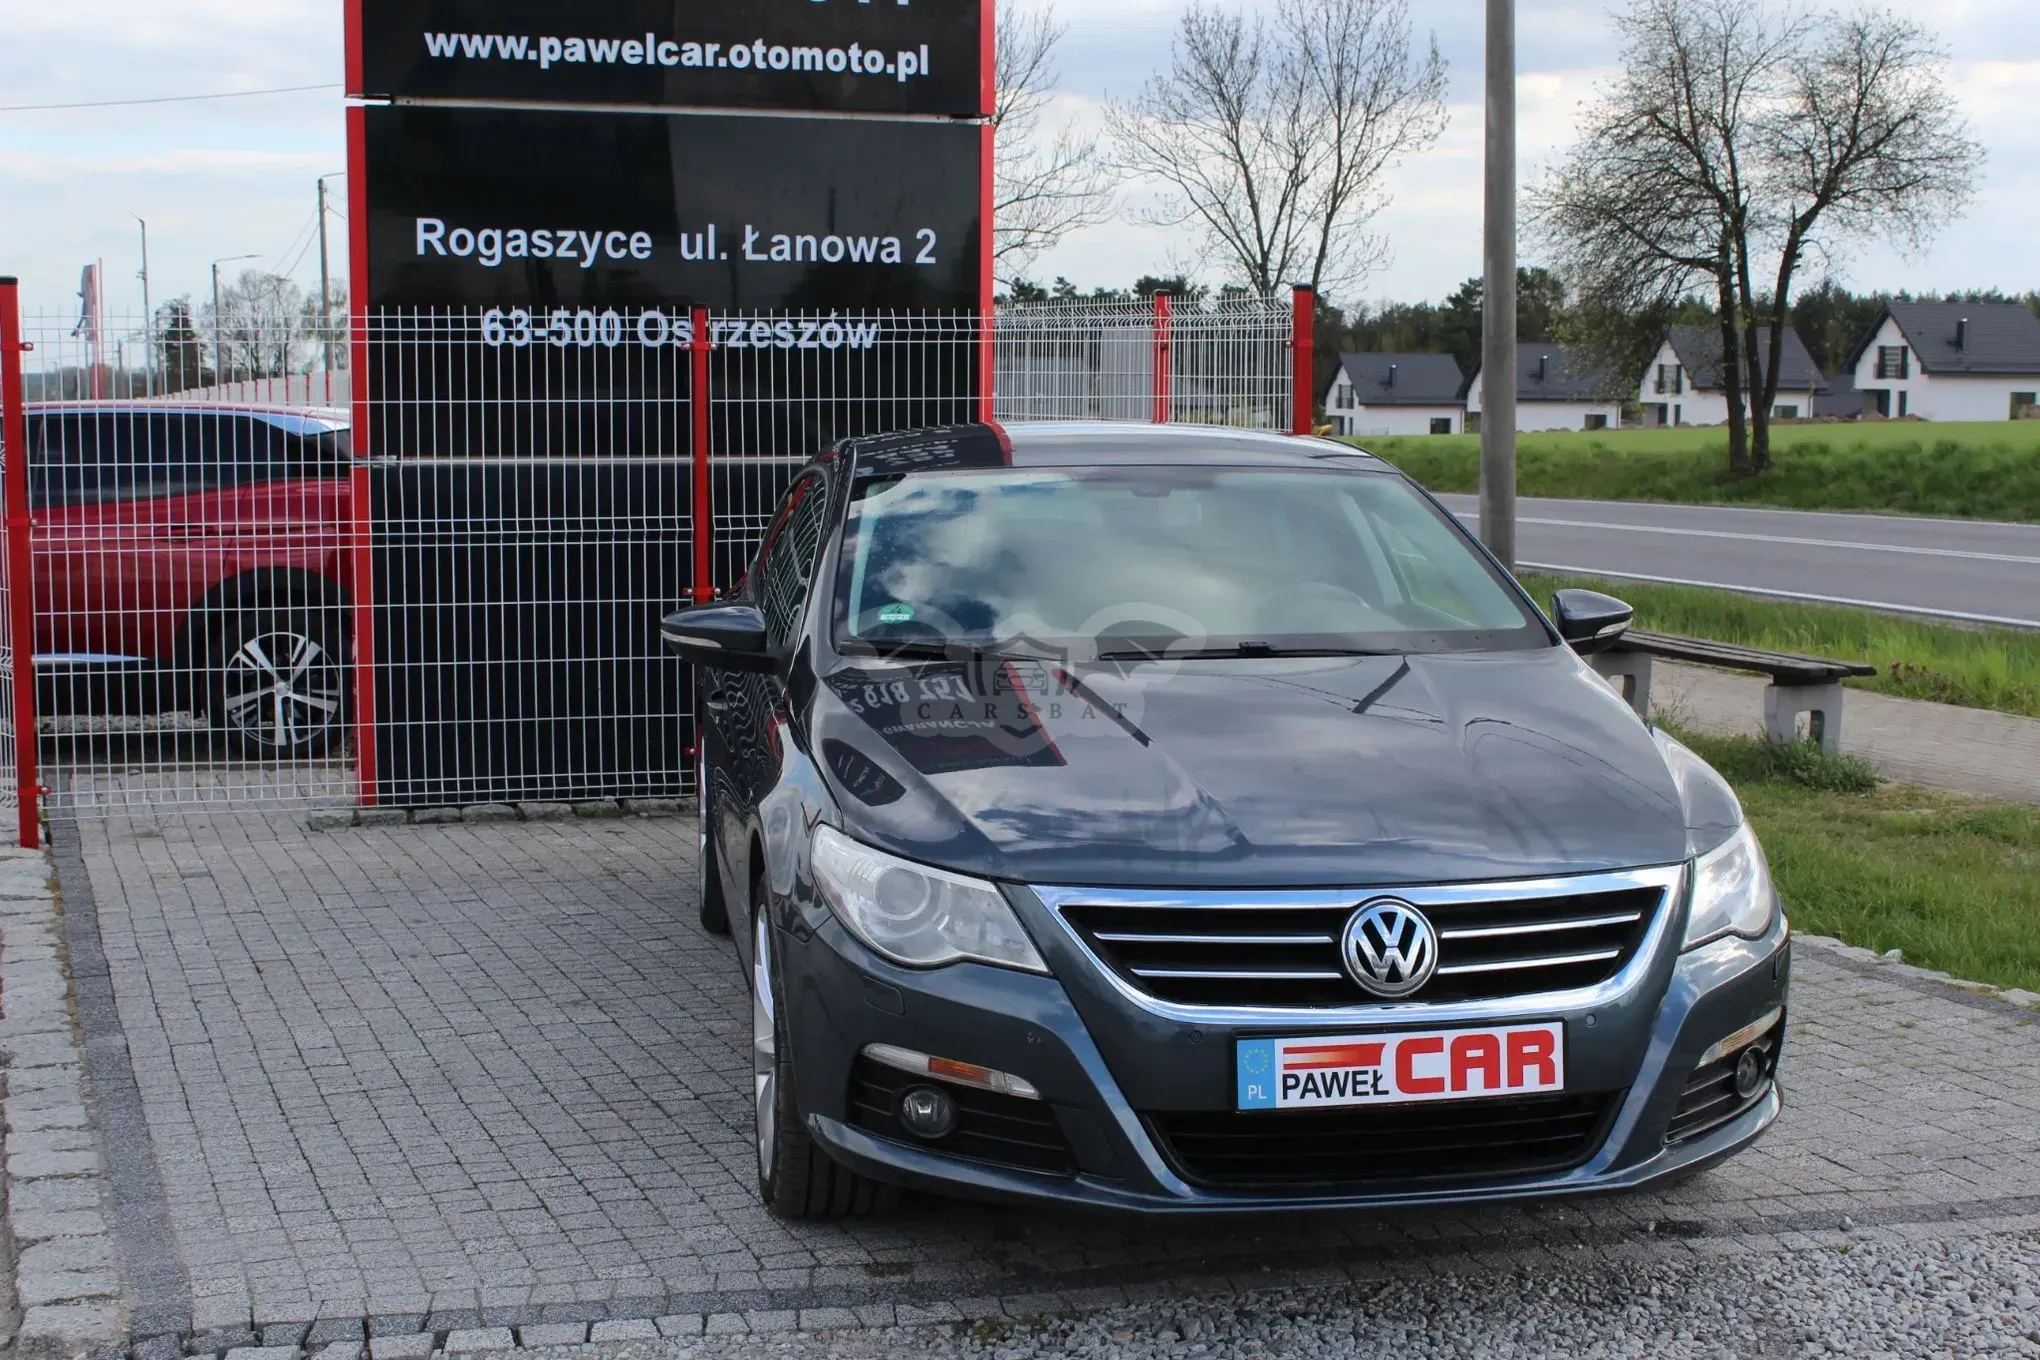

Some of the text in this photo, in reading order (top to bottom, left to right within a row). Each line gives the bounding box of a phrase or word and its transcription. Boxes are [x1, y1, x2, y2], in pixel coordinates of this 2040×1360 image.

[424, 32, 929, 82] www.pawelcar.otomoto.pl
[415, 217, 937, 268] Rogaszyce ul. Łanowa 2
[482, 309, 878, 349] 63-500 Osrzeszów
[1350, 905, 1431, 987] VW
[1281, 1029, 1556, 1101] PAWEŁ CAR
[1247, 1084, 1268, 1101] PL
